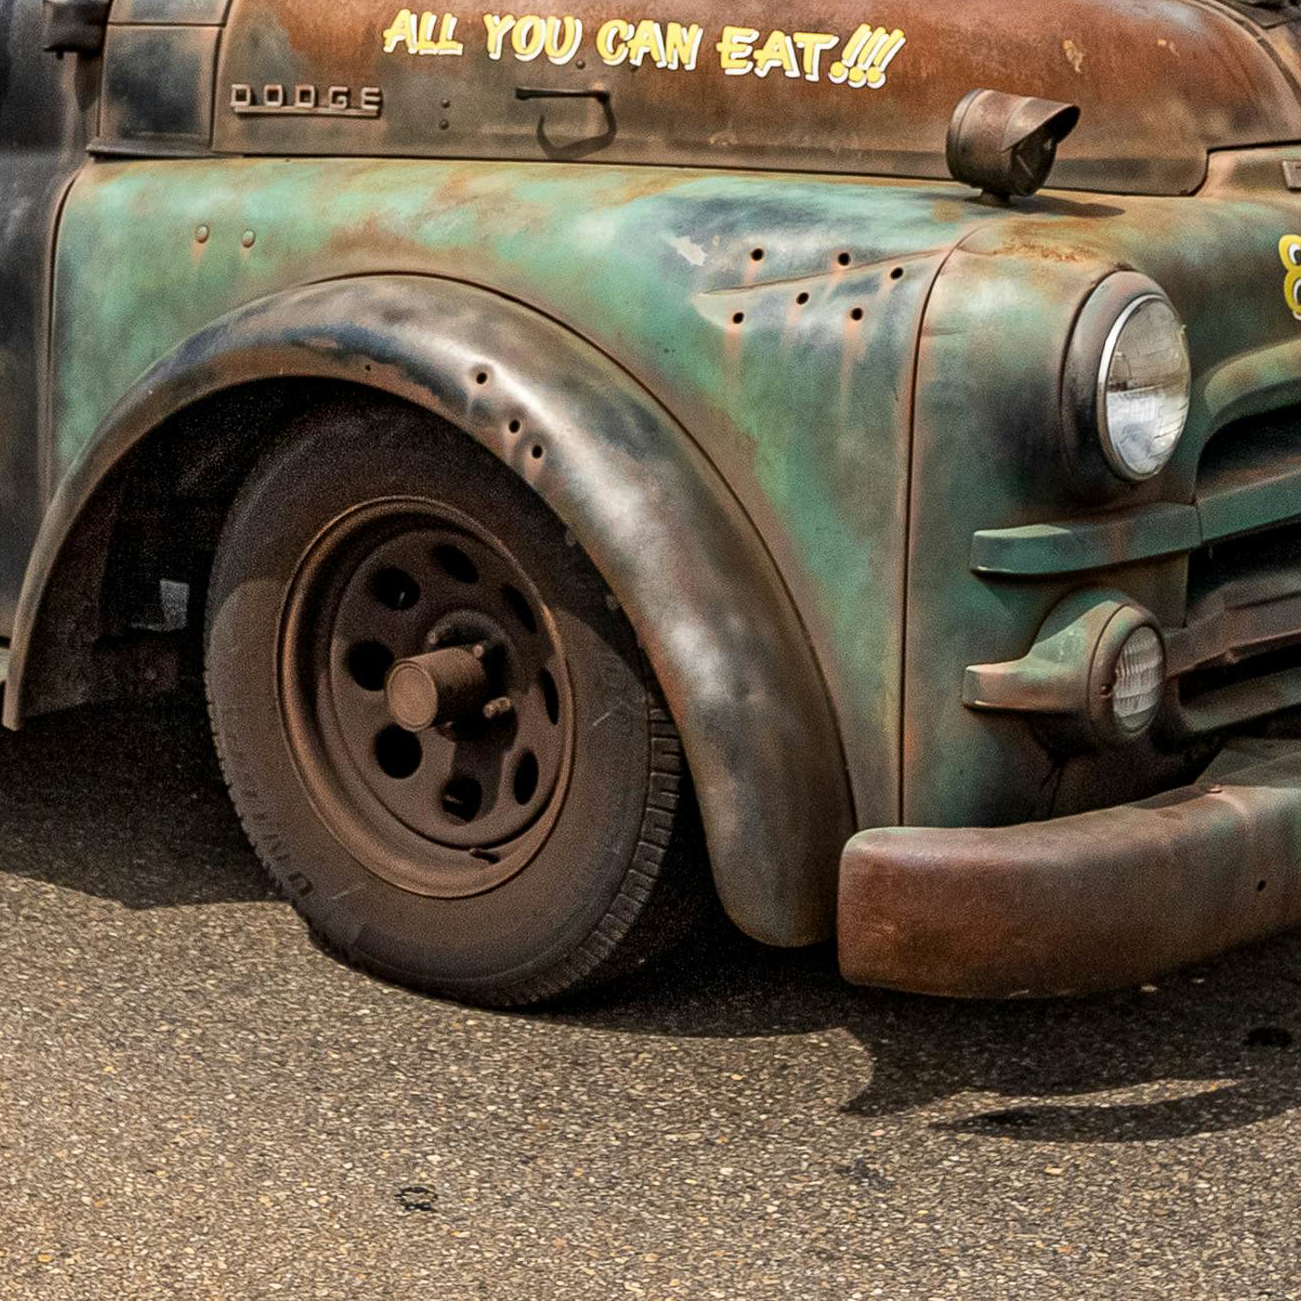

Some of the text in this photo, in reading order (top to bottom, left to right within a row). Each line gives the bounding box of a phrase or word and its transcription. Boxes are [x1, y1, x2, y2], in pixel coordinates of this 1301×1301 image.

[383, 8, 907, 90] ALL YOU CAN EAT!!!
[230, 84, 382, 112] DODGE
